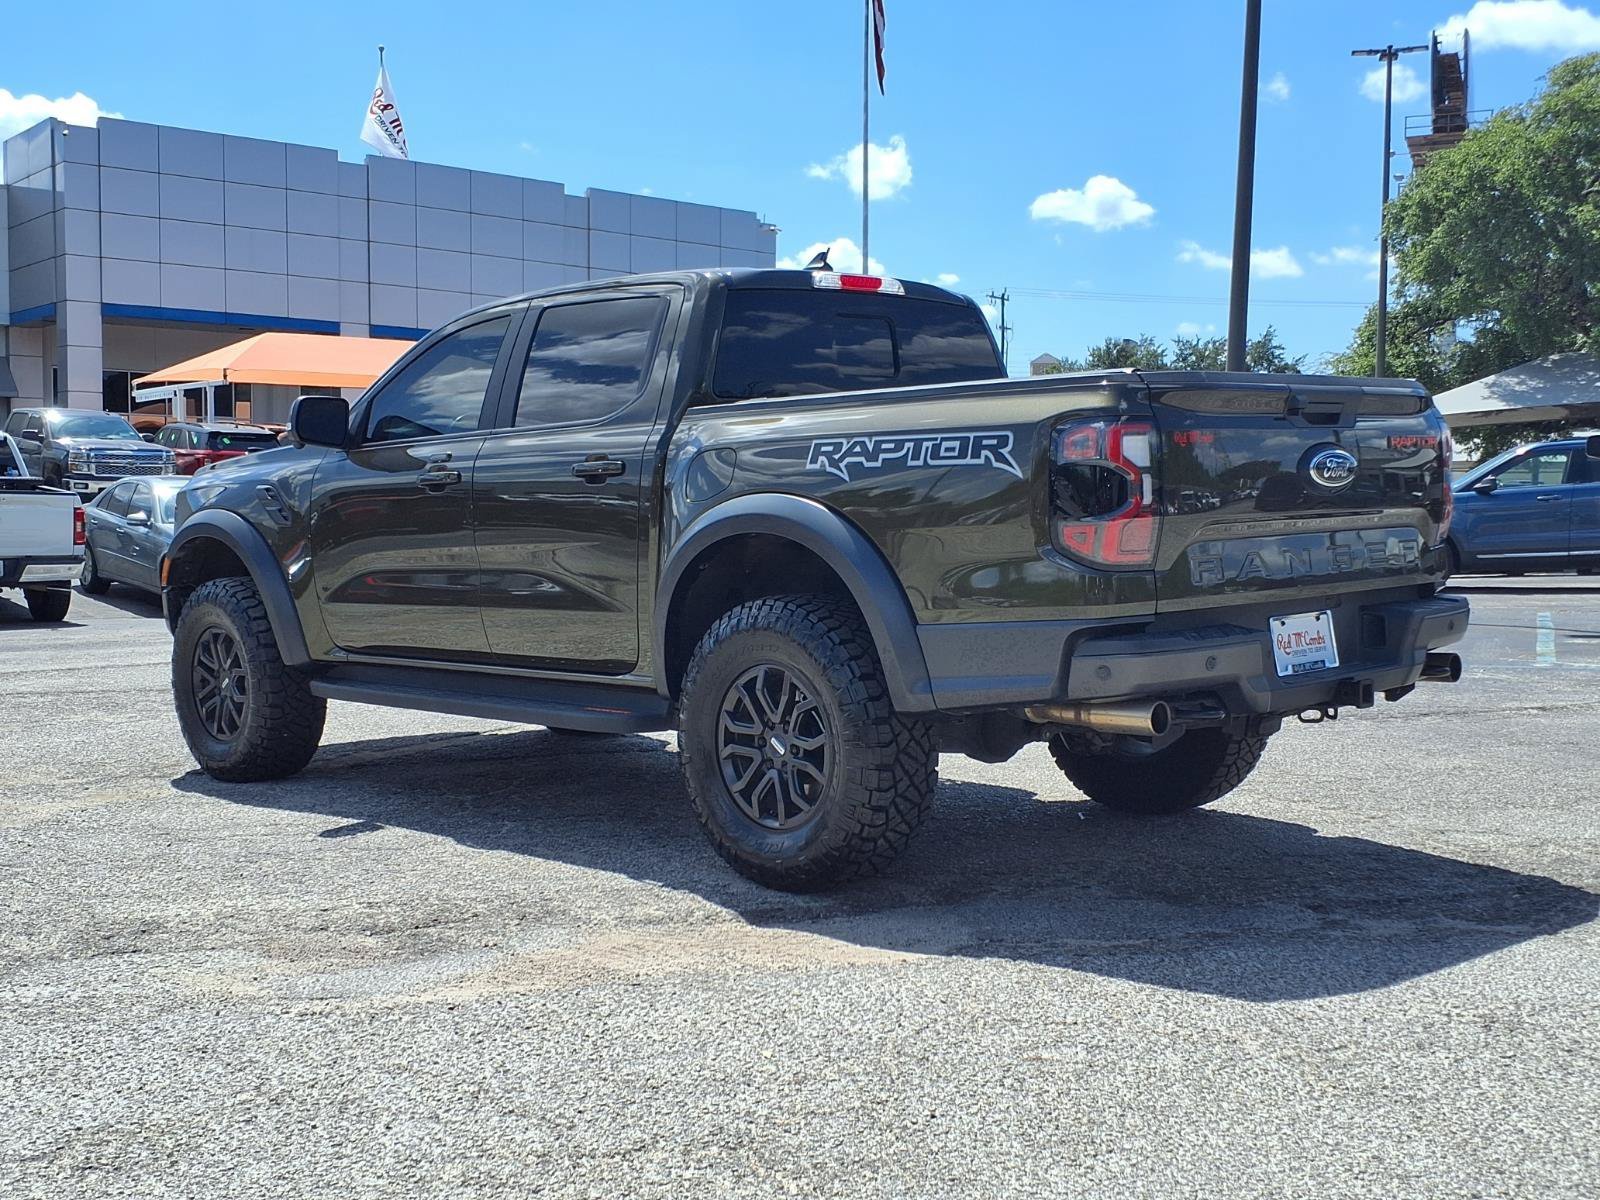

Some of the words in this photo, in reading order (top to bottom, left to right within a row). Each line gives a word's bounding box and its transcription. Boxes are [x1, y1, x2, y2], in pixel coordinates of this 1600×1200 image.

[374, 115, 400, 145] DRIVEN
[1391, 435, 1437, 448] RAPTOR
[806, 431, 1023, 482] RAPTOR
[1323, 457, 1350, 478] Ford
[1191, 540, 1421, 586] RANGER
[1277, 634, 1291, 655] Red
